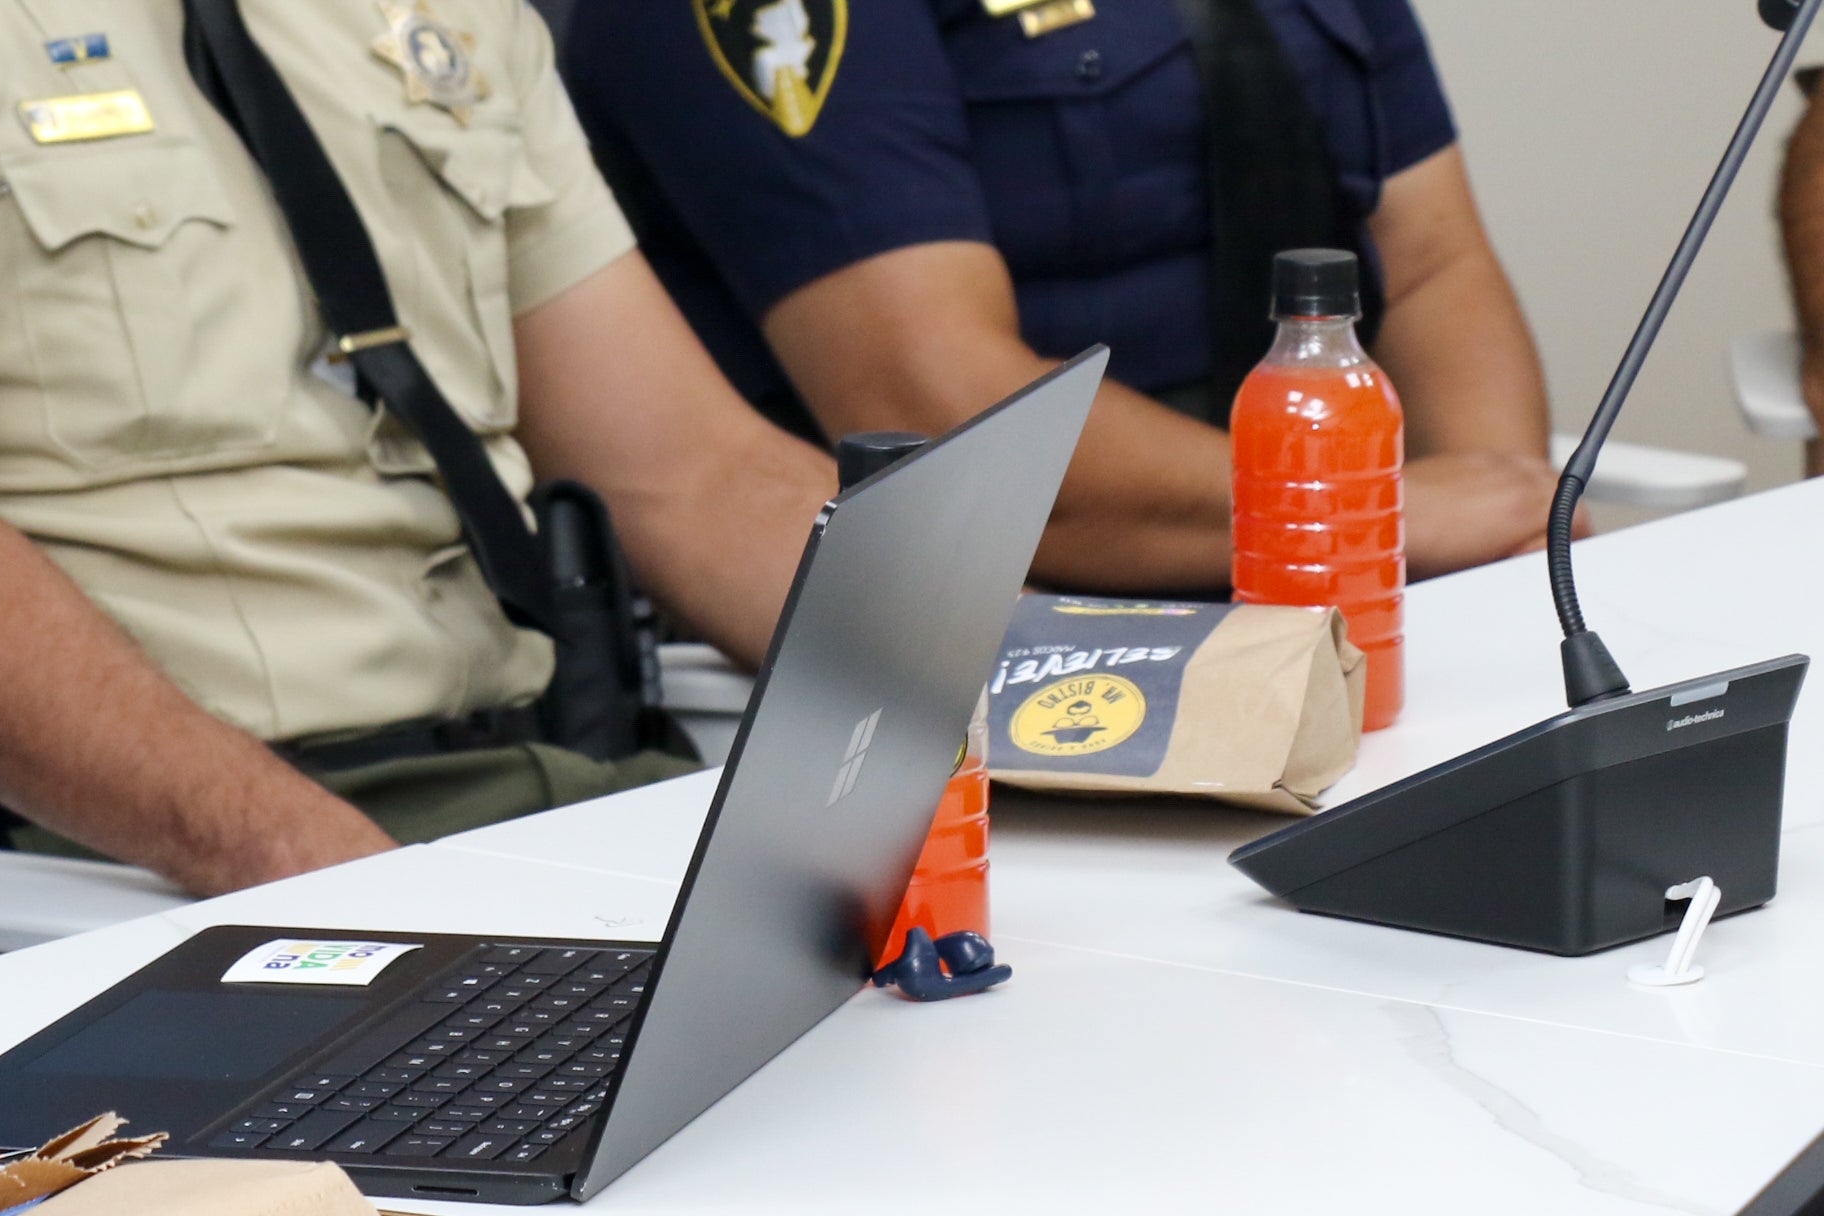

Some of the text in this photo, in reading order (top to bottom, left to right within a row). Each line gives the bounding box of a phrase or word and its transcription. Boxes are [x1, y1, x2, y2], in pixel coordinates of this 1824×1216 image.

[990, 645, 1182, 694] BELIEVE!
[1037, 681, 1095, 710] BISTRO
[1673, 709, 1725, 729] audio-technica
[263, 954, 301, 969] na
[292, 945, 358, 970] VIDA
